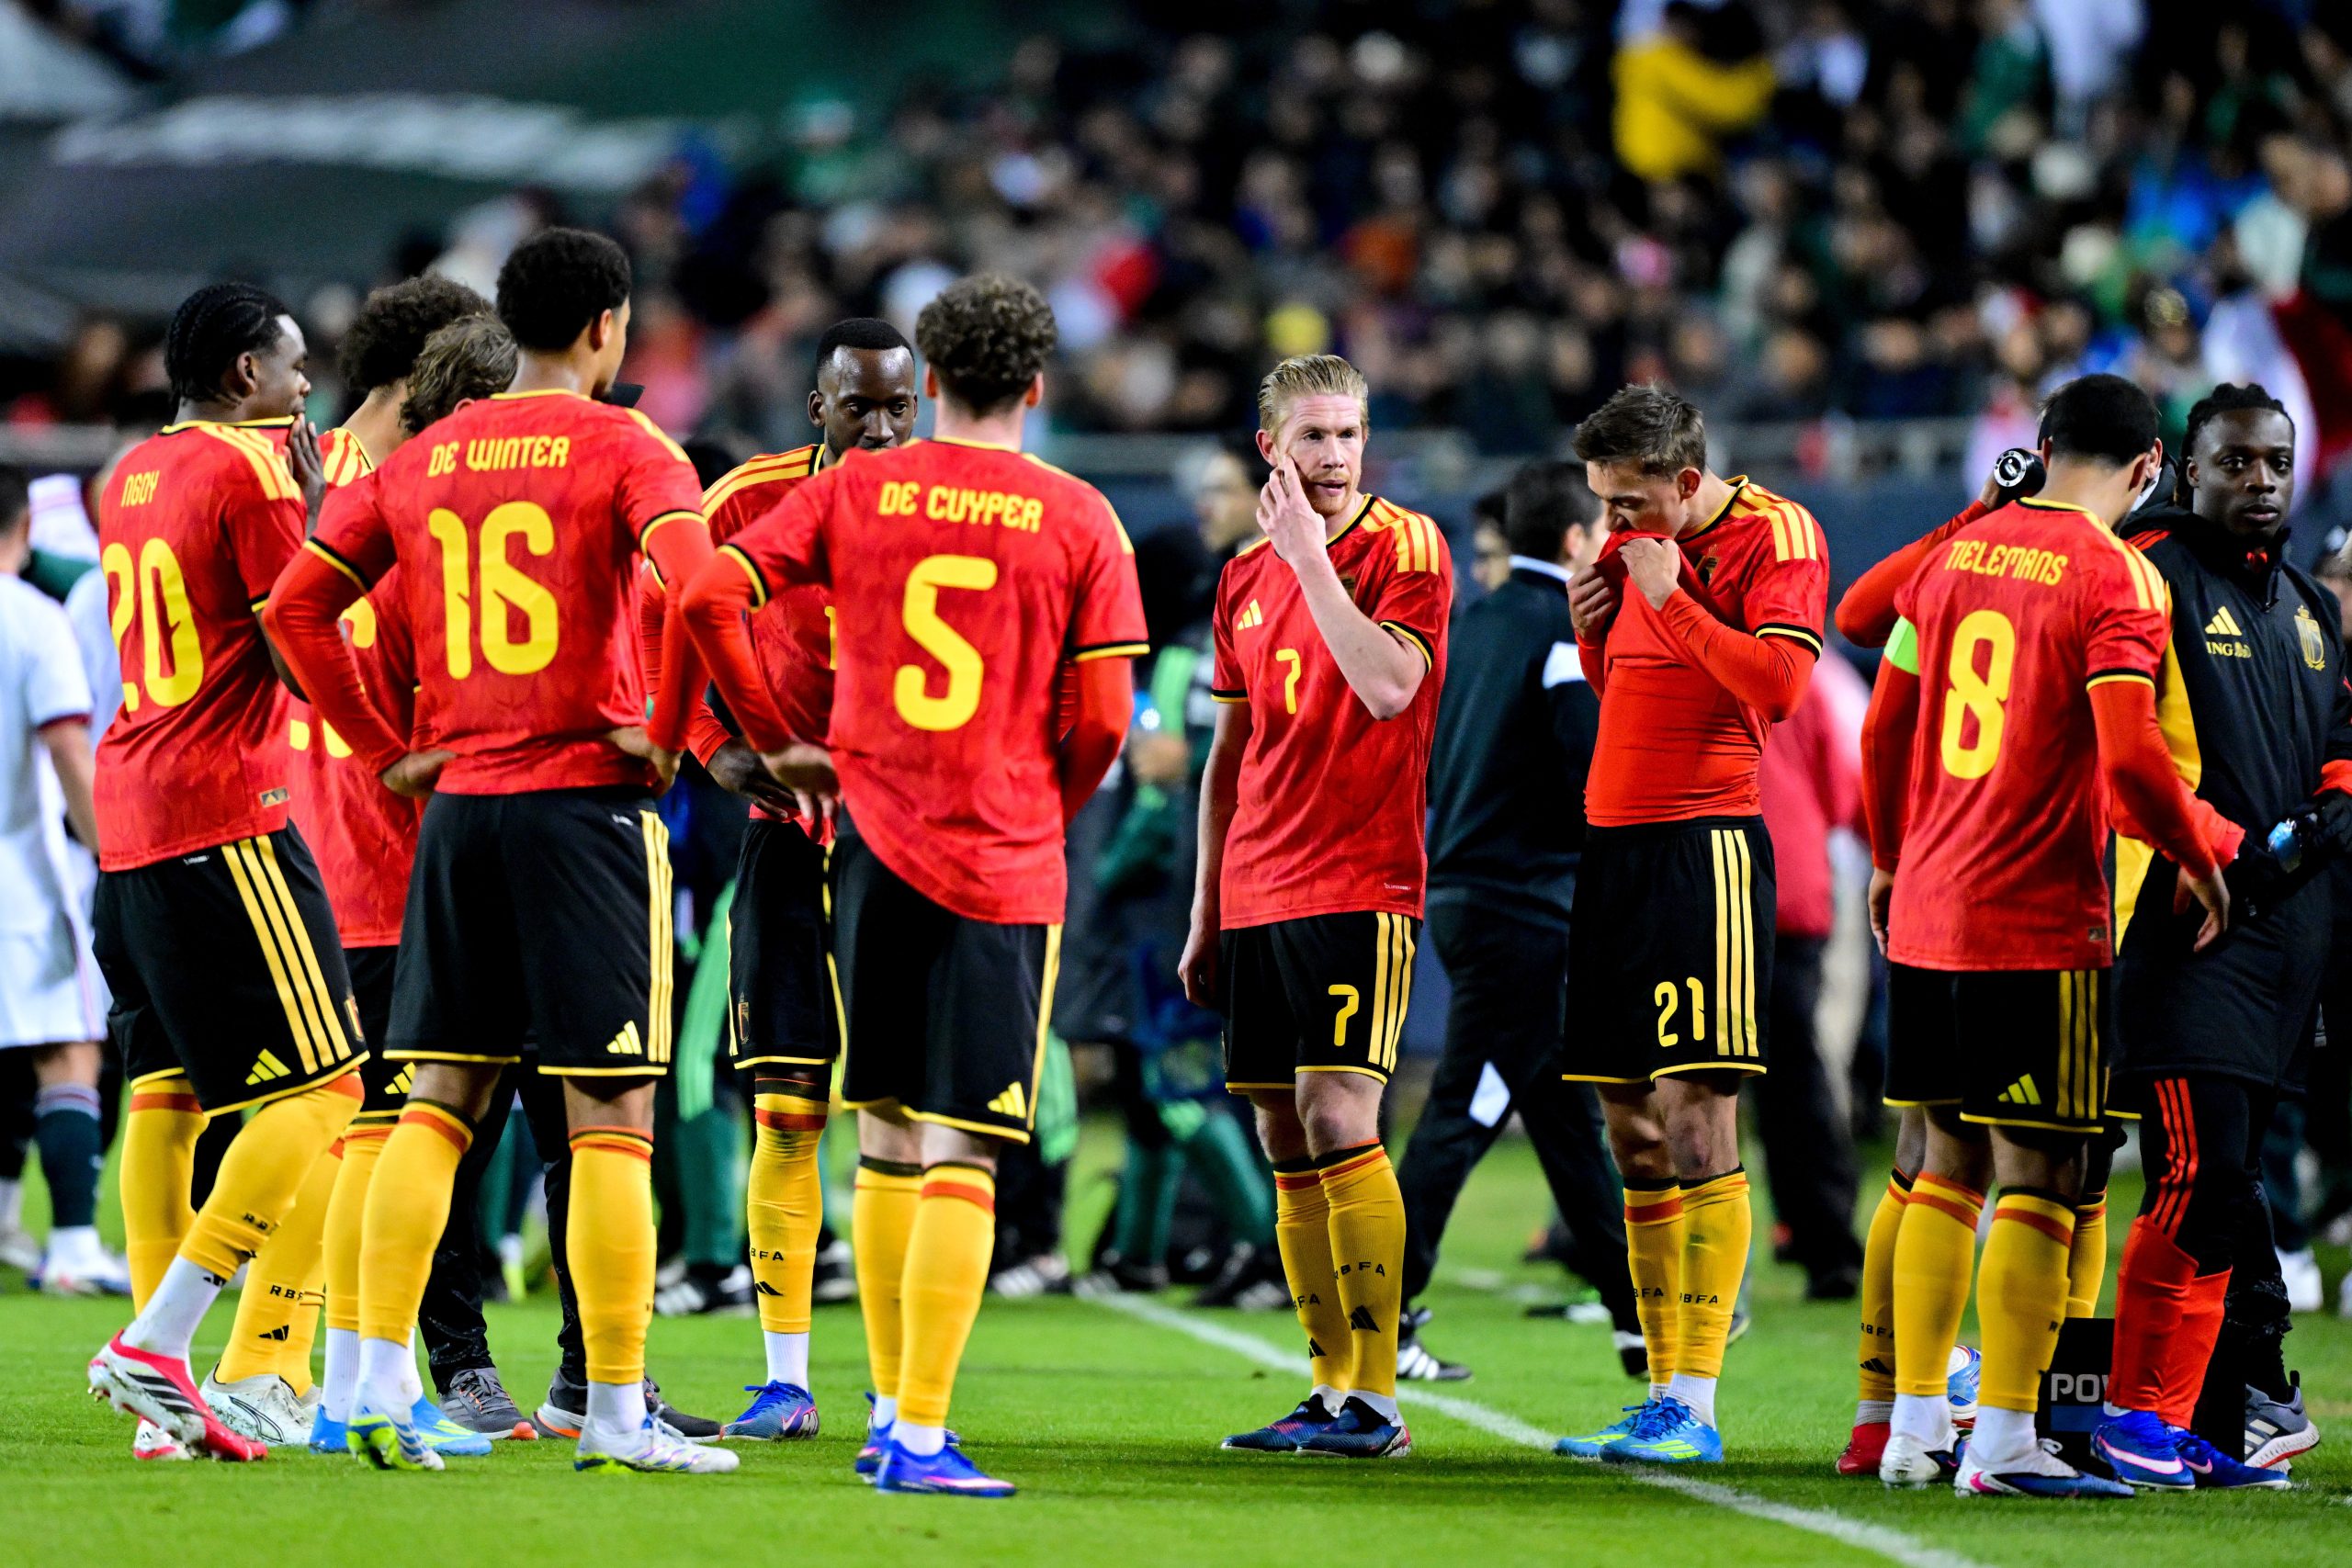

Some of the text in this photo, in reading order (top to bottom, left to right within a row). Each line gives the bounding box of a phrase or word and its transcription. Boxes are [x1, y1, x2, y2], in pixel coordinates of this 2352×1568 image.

[428, 435, 571, 477] DE WINTER
[121, 470, 160, 507] NGOY
[879, 482, 1043, 533] DE CUYPER
[429, 502, 559, 680] 16
[1945, 540, 2068, 586] TIELEMANS
[102, 537, 204, 712] 20
[895, 555, 998, 731] 5
[2206, 640, 2234, 658] ING
[1275, 649, 1301, 715] 7
[1940, 610, 2015, 780] 8
[1328, 984, 1360, 1047] 7
[1654, 976, 1706, 1048] 21
